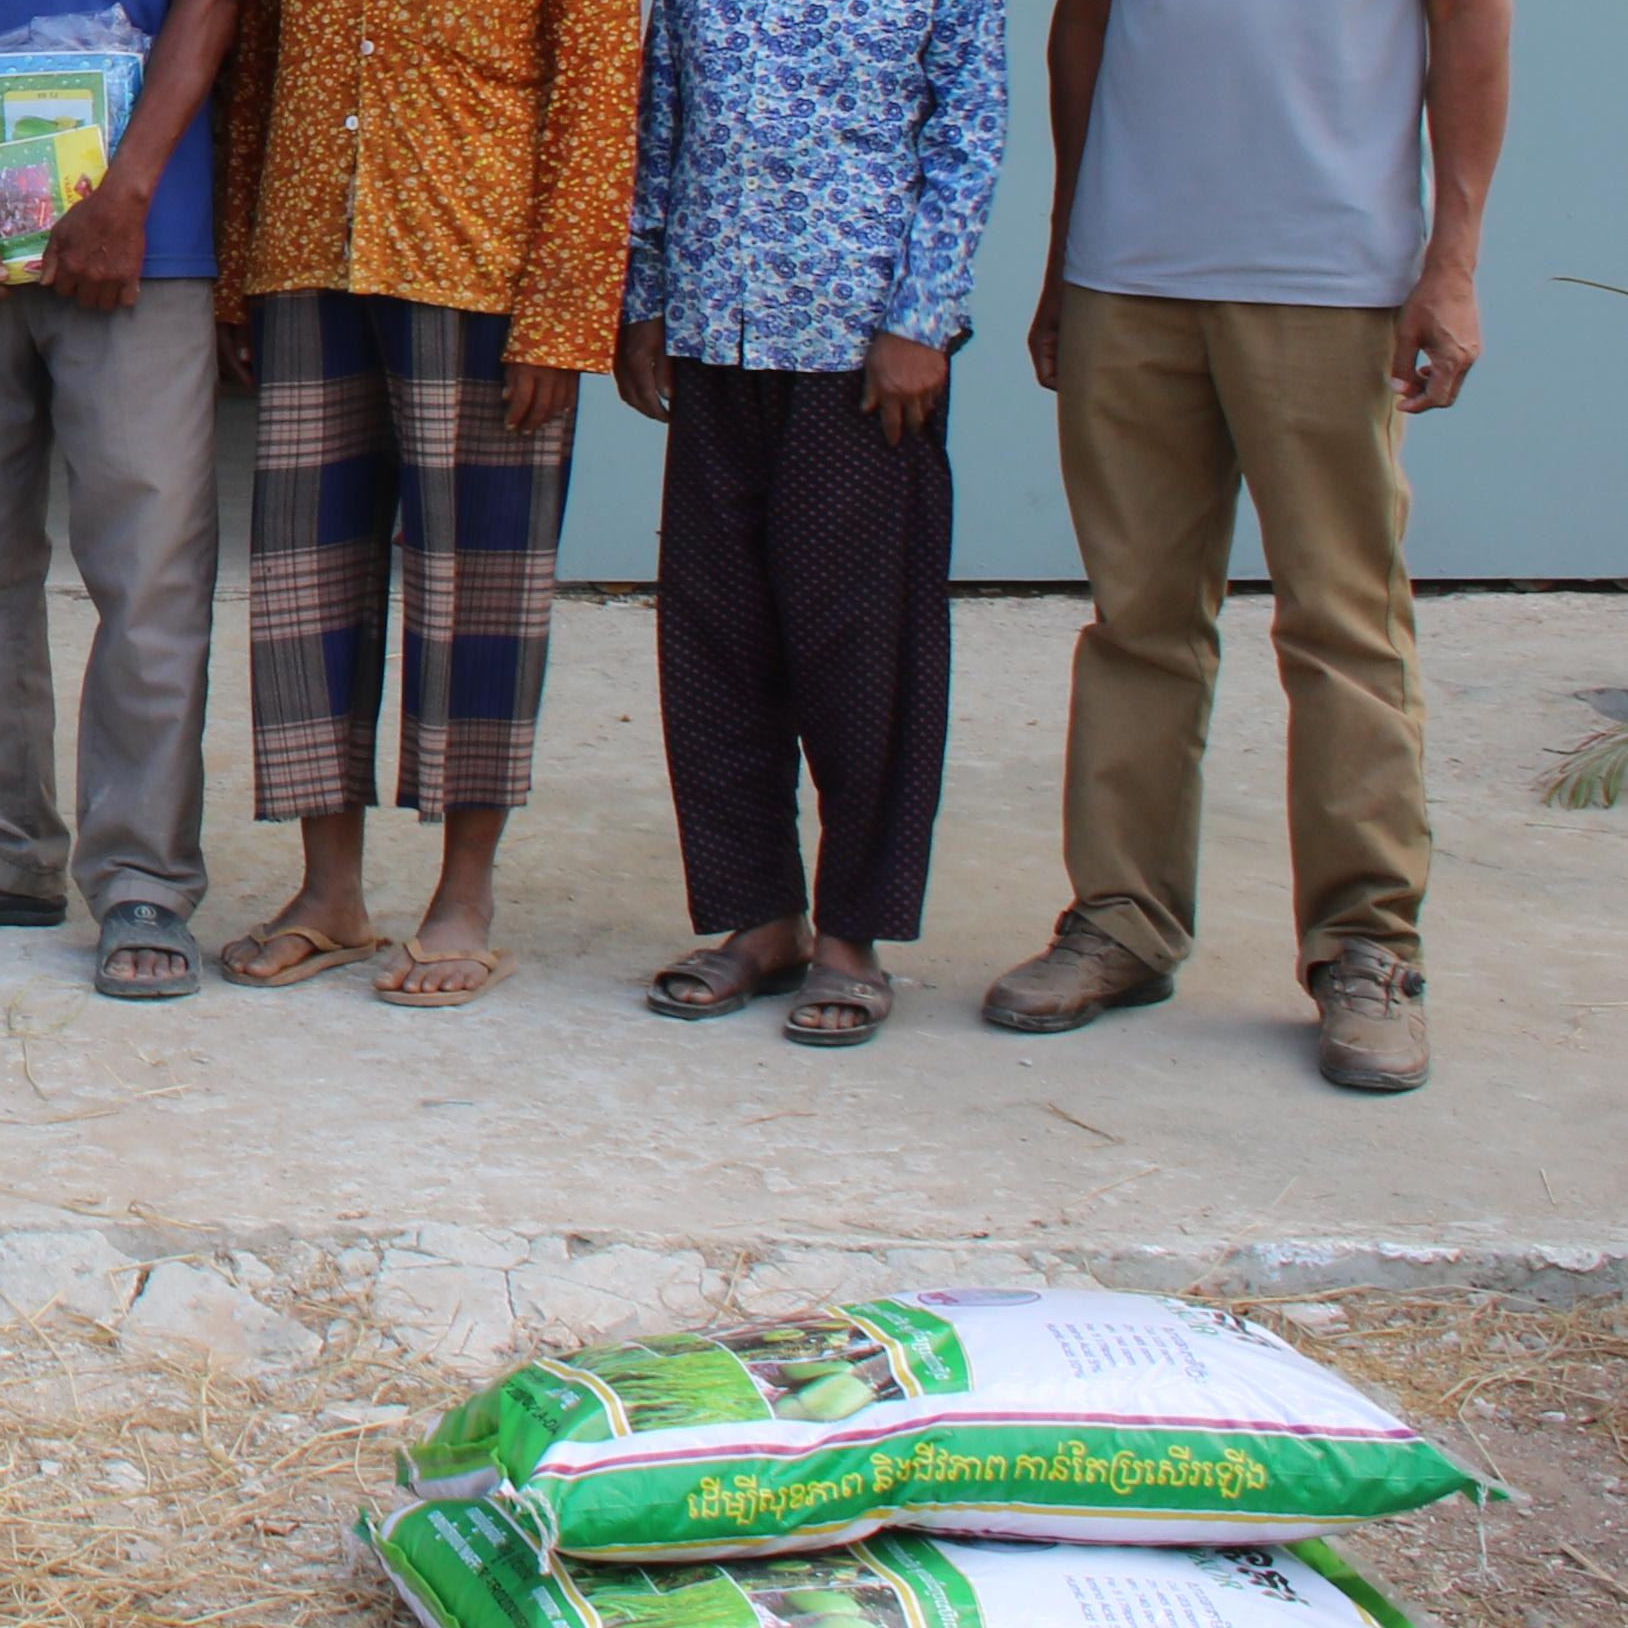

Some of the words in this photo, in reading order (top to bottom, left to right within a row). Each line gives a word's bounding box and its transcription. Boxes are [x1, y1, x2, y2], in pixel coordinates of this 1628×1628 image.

[688, 1472, 863, 1526] ដើម្បីសុខភាព
